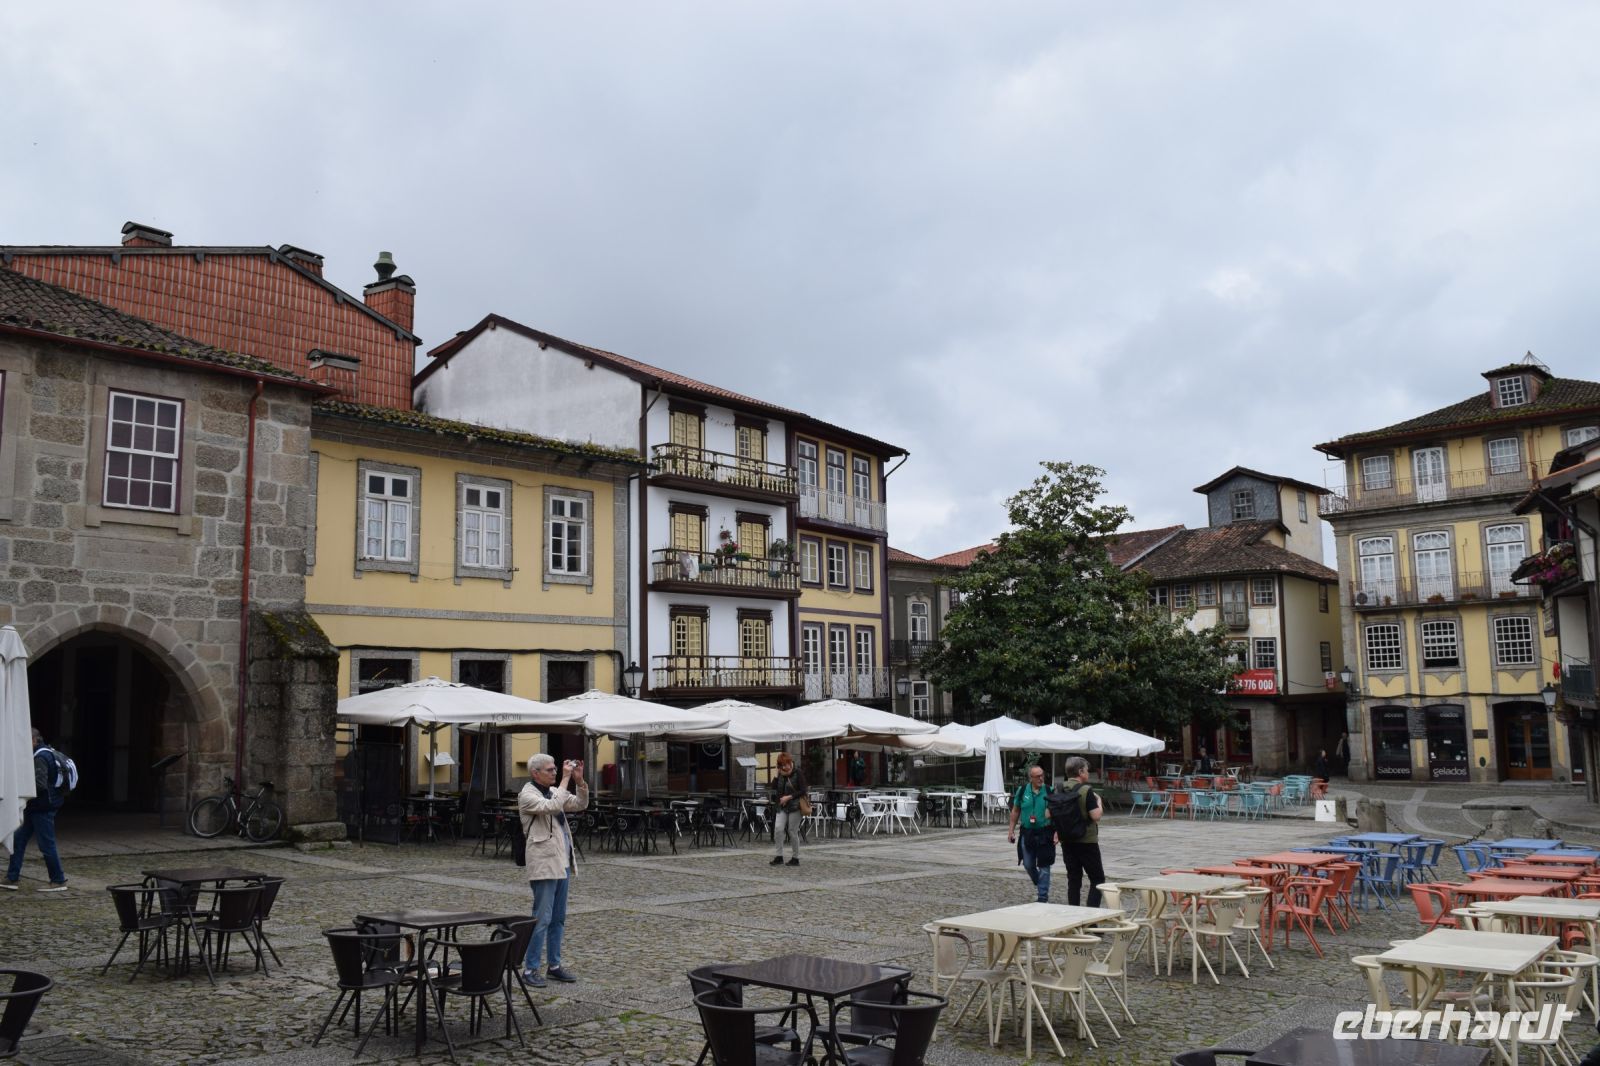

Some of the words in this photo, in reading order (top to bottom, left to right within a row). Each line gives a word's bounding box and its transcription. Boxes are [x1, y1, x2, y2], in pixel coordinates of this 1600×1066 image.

[1244, 679, 1257, 690] 776
[1258, 679, 1274, 690] 000
[1377, 766, 1411, 775] Sabores
[1432, 766, 1467, 778] gelados
